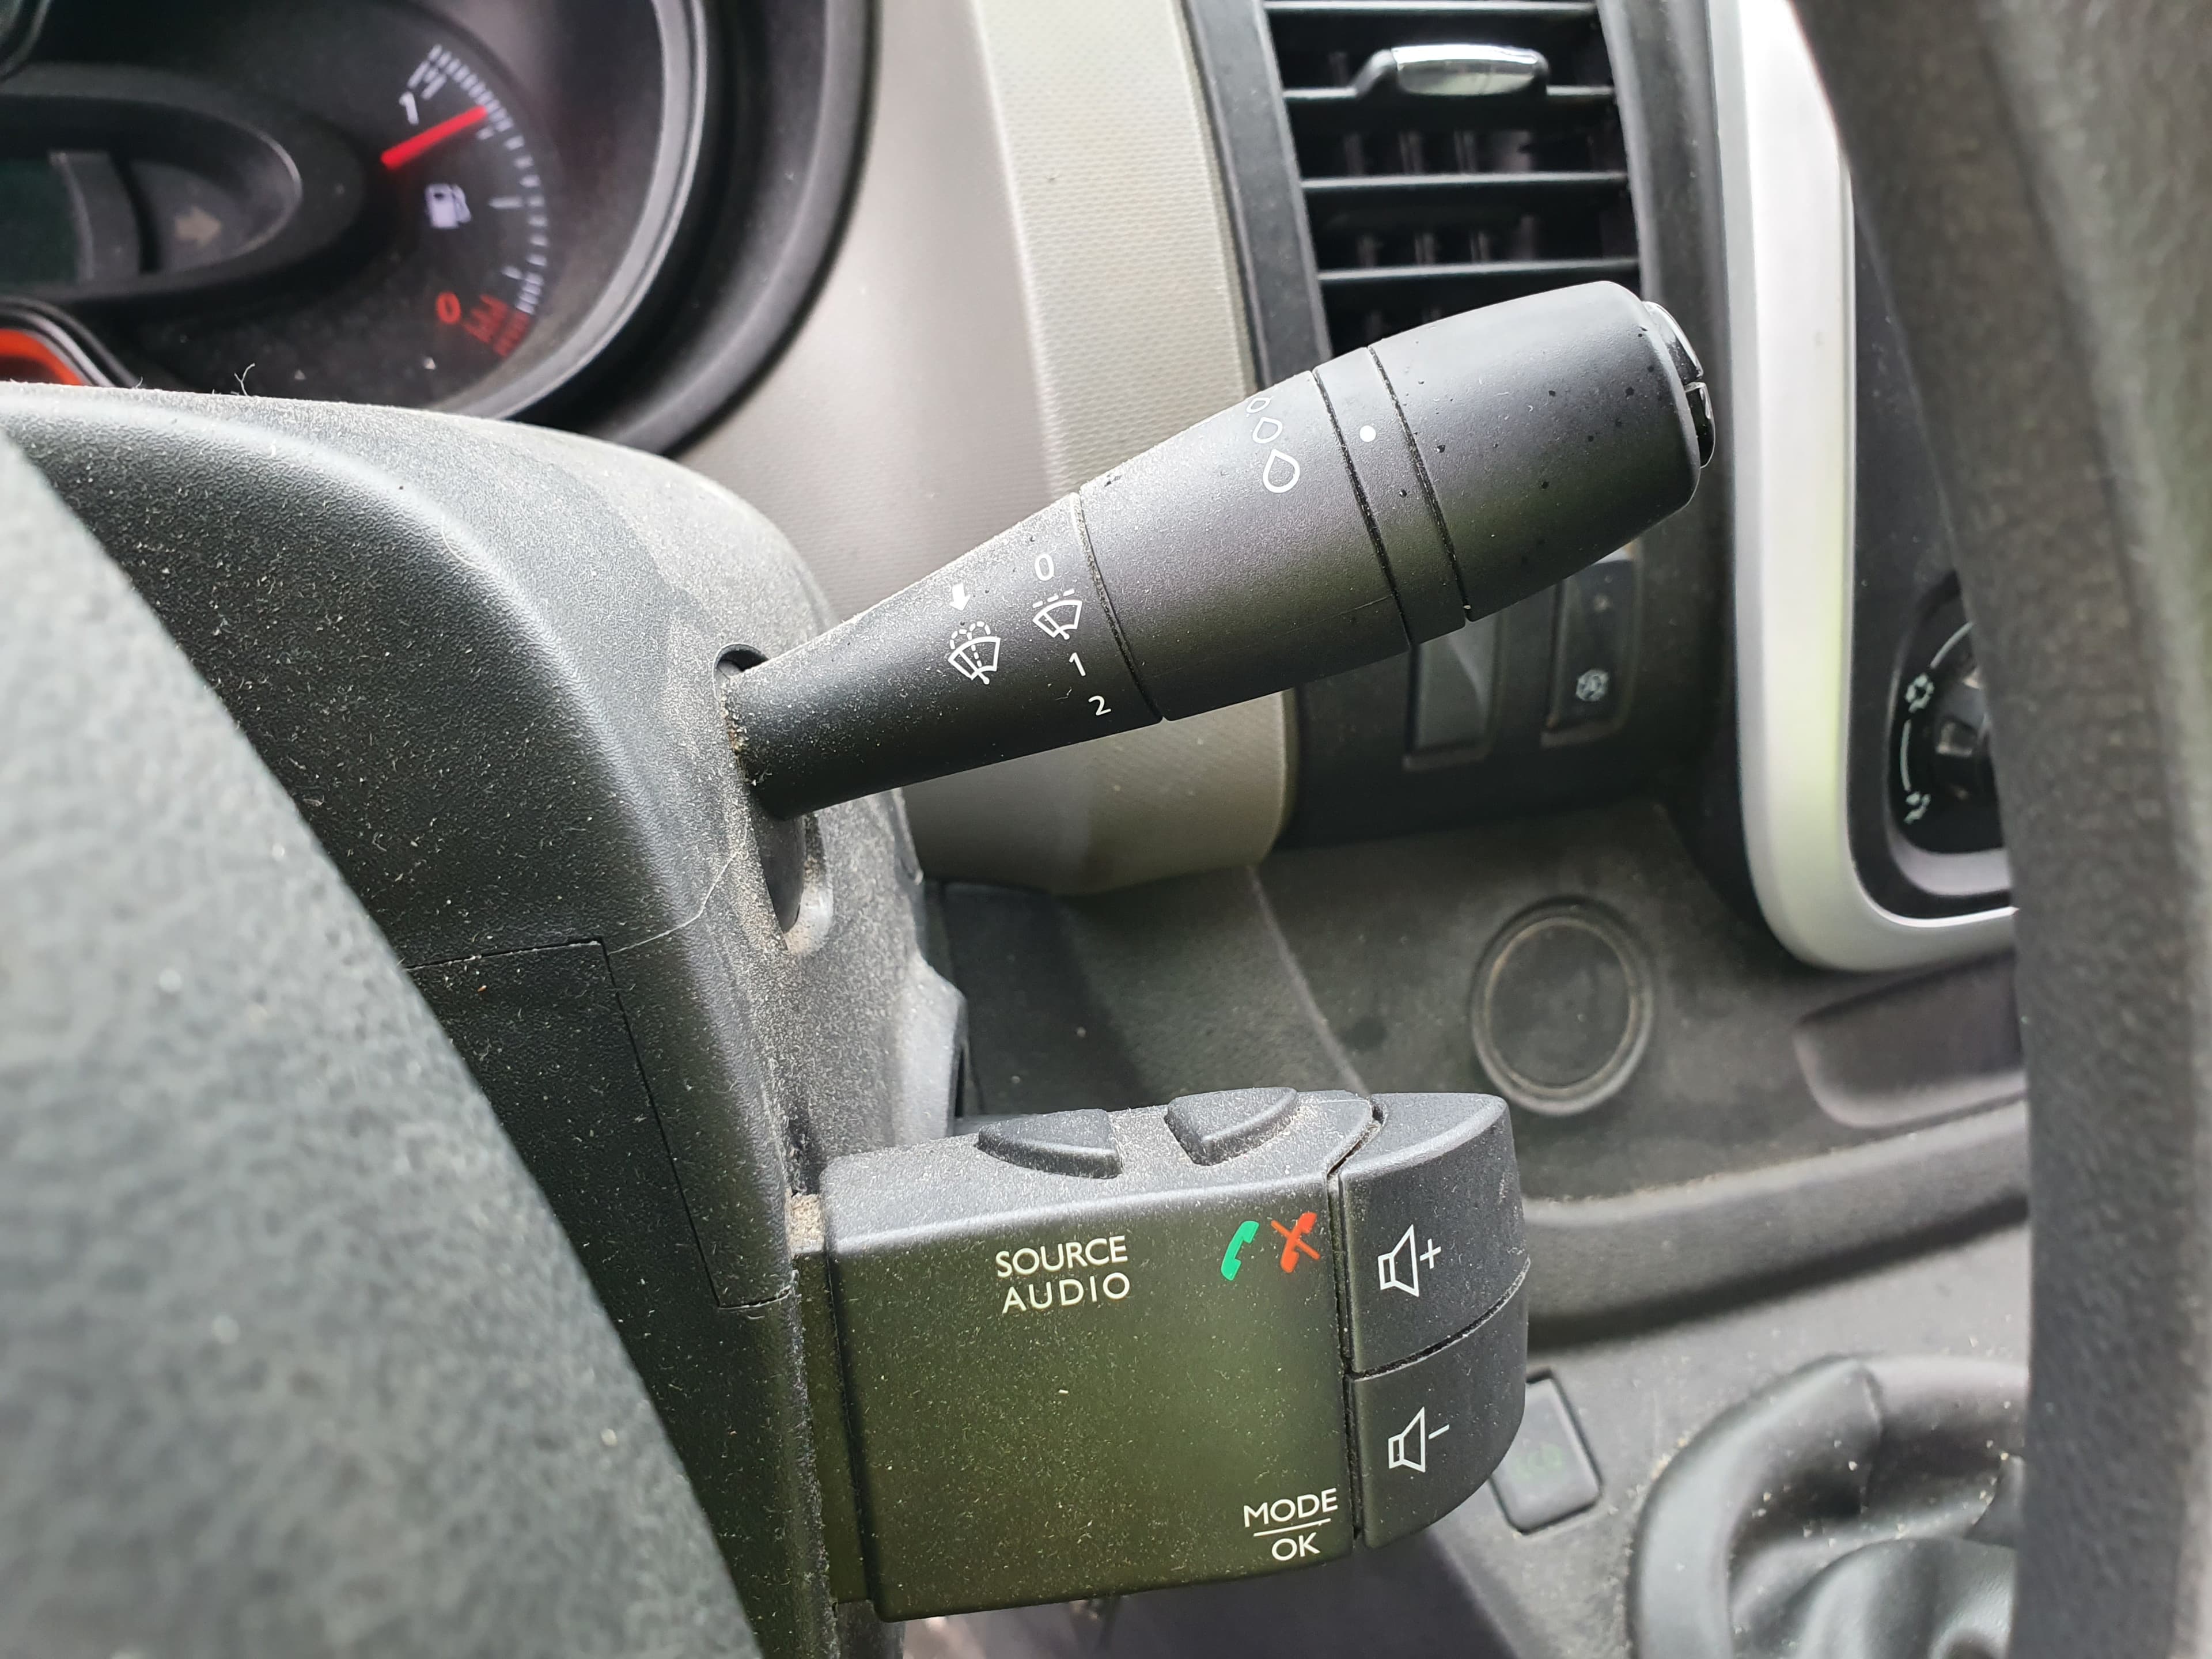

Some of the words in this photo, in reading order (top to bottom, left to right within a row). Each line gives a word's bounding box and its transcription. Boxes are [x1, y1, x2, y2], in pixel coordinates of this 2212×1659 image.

[399, 92, 419, 125] 1
[436, 291, 461, 324] 0
[1035, 554, 1055, 581] 0
[1069, 652, 1086, 676] 1
[1088, 695, 1112, 715] 2
[995, 1236, 1128, 1278] SOURCE
[1002, 1272, 1130, 1314] AUDIO
[1243, 1487, 1338, 1528] MODE
[1271, 1532, 1321, 1561] OK
